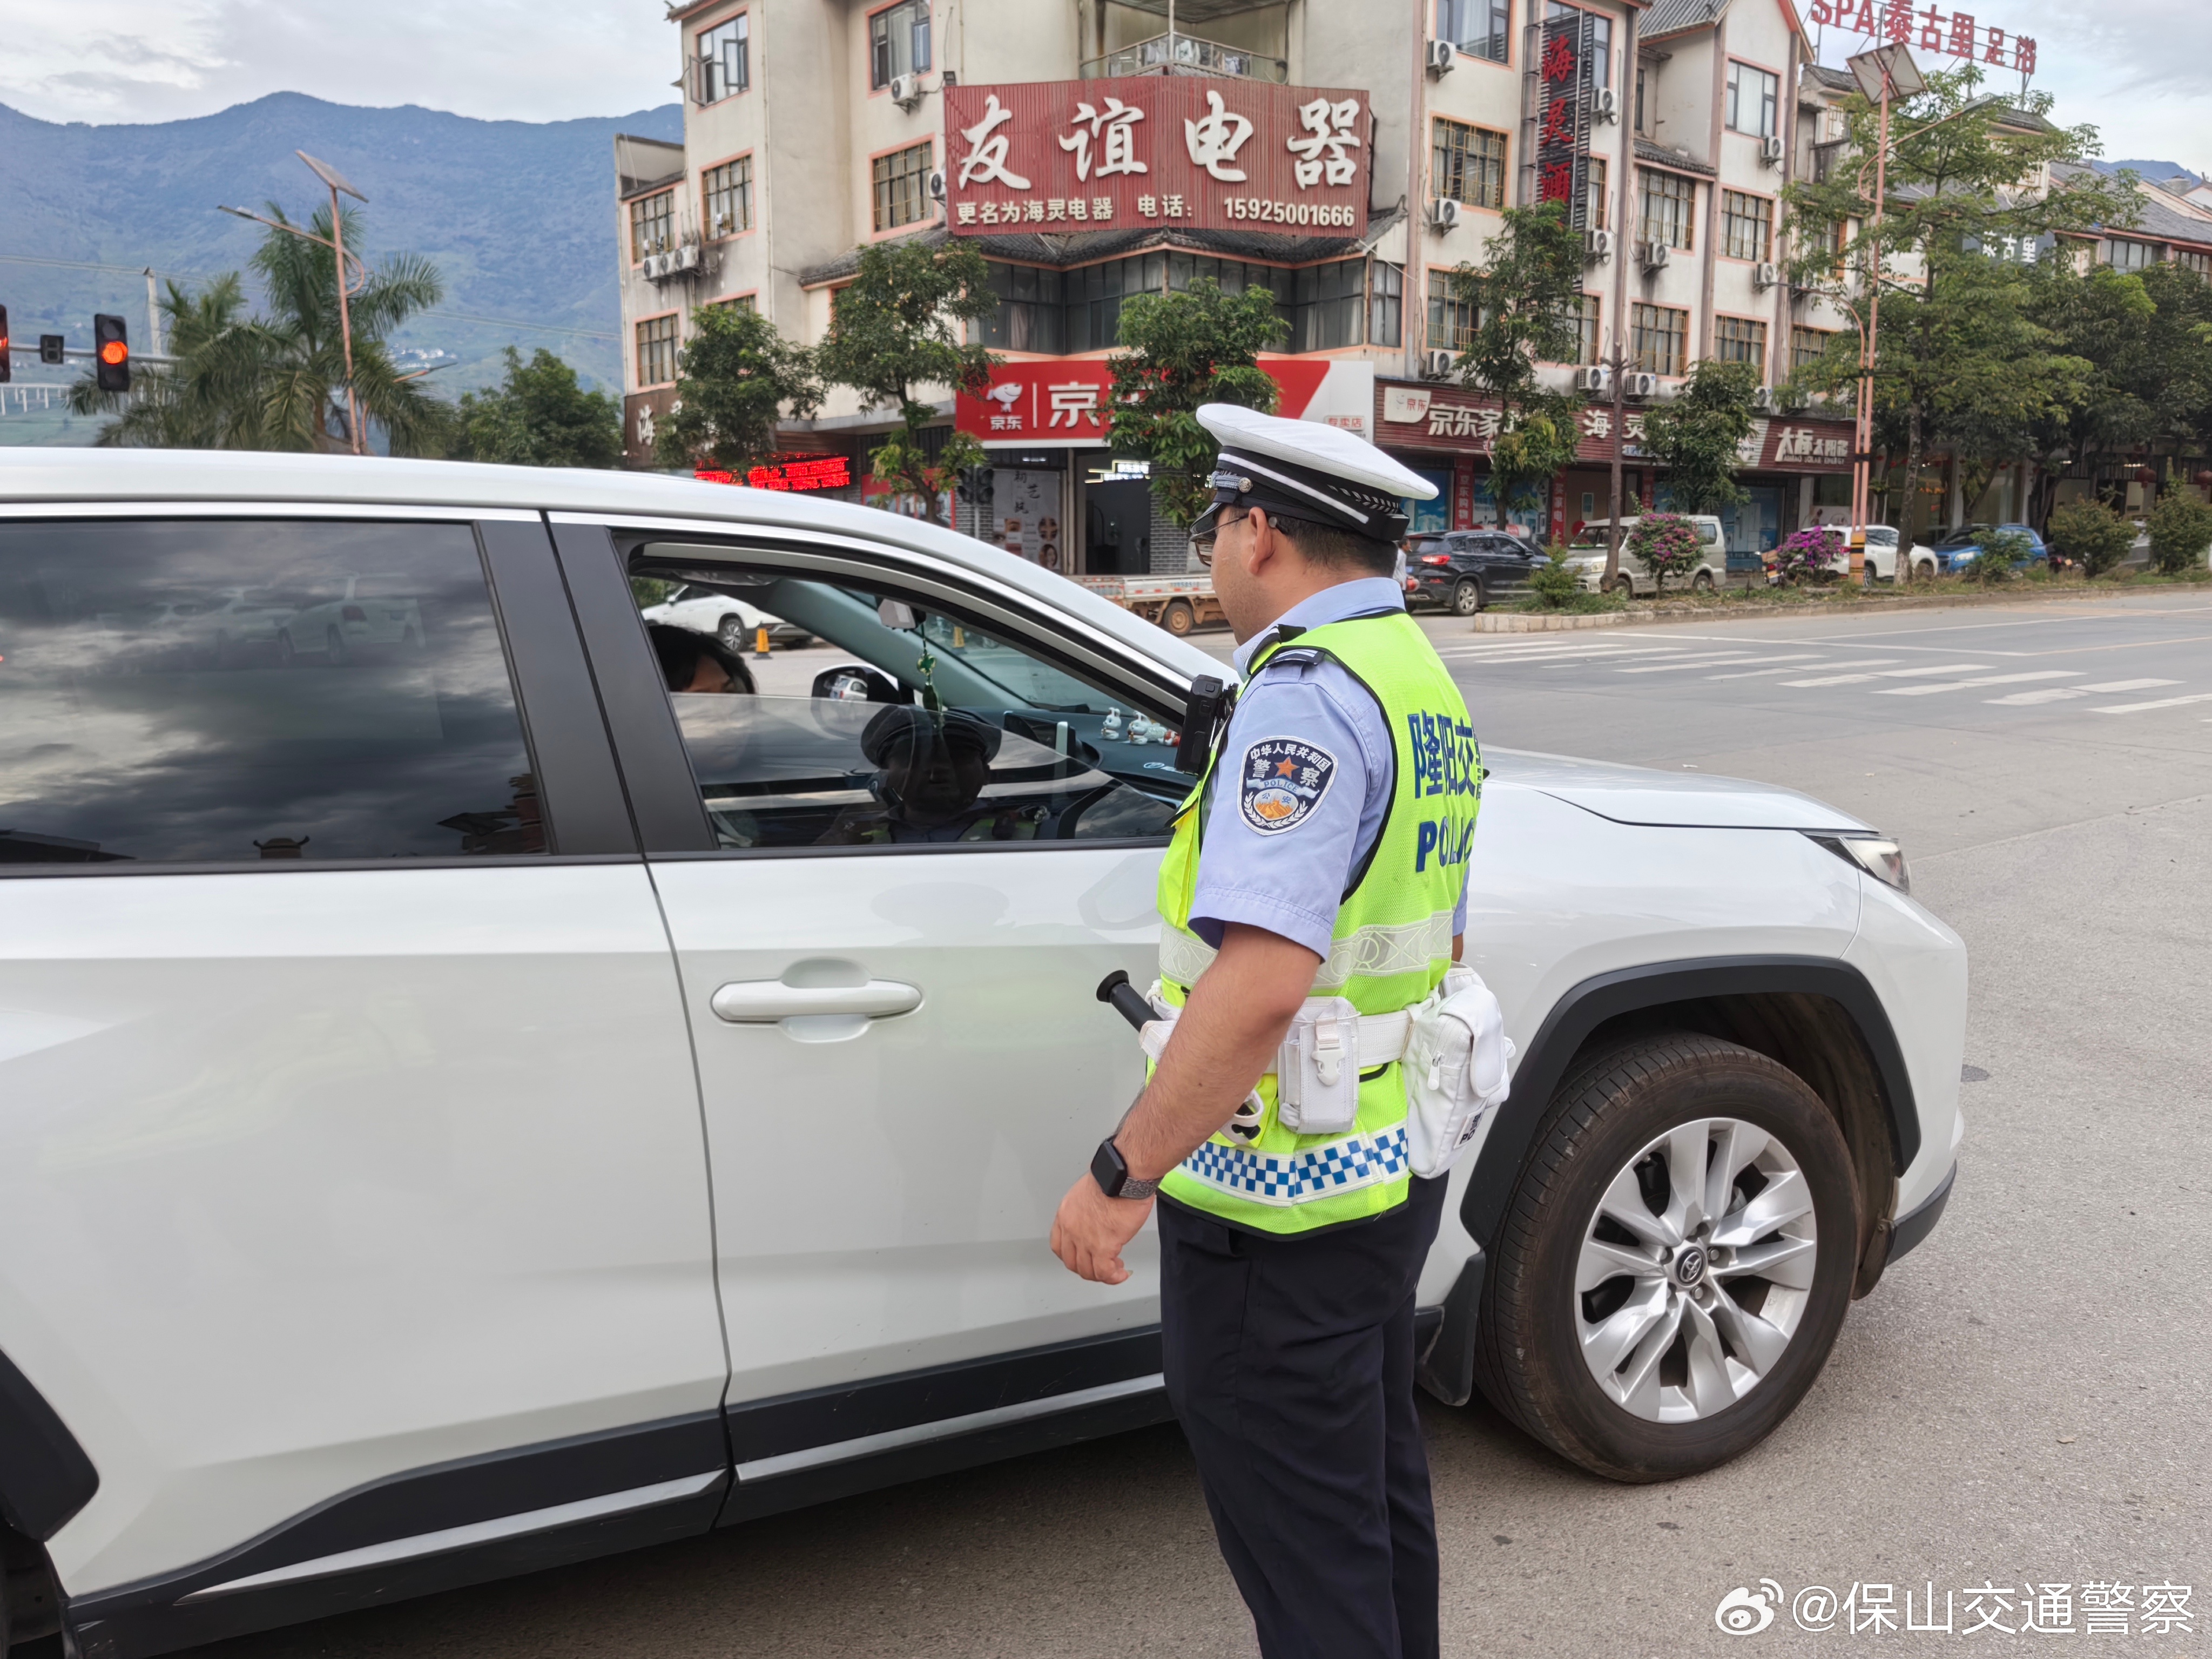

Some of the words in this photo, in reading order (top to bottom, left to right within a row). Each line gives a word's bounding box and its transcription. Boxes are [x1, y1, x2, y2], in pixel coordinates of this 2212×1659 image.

[958, 90, 1361, 190] 友谊电器
[1540, 35, 1575, 231] 海灵酒
[956, 197, 1114, 225] 更名为海灵电器
[1224, 198, 1355, 227] 15925001666
[1406, 398, 1427, 412] 京东
[990, 415, 1023, 431] 京东
[1250, 743, 1332, 772] 中华人民共和国
[1264, 779, 1299, 792] POLICE
[1262, 792, 1292, 804] 公安
